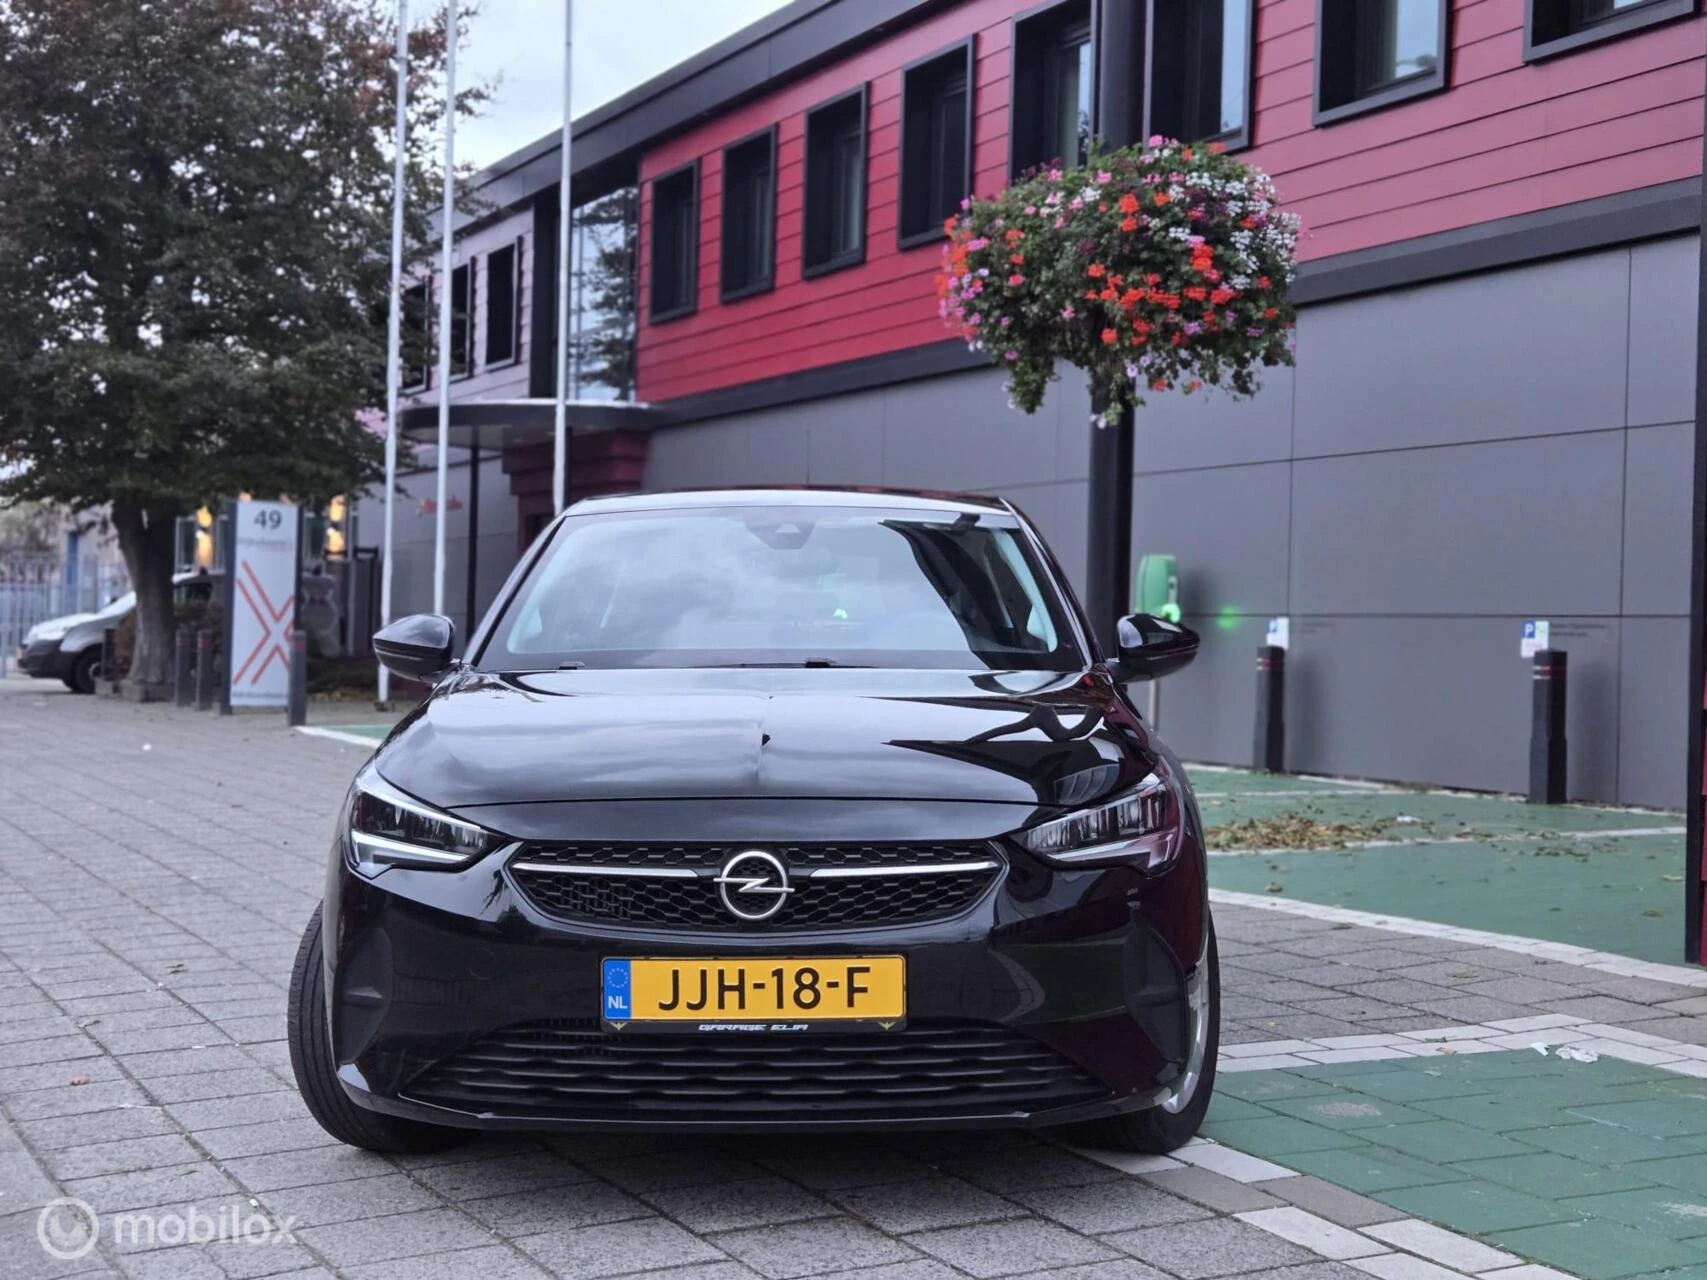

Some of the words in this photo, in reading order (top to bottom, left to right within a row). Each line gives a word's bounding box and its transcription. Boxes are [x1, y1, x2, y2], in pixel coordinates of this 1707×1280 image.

[253, 509, 282, 530] 49
[1524, 623, 1534, 638] P
[658, 966, 870, 1011] JJH-18-F
[608, 996, 628, 1009] NL
[698, 1024, 766, 1032] GARAGE
